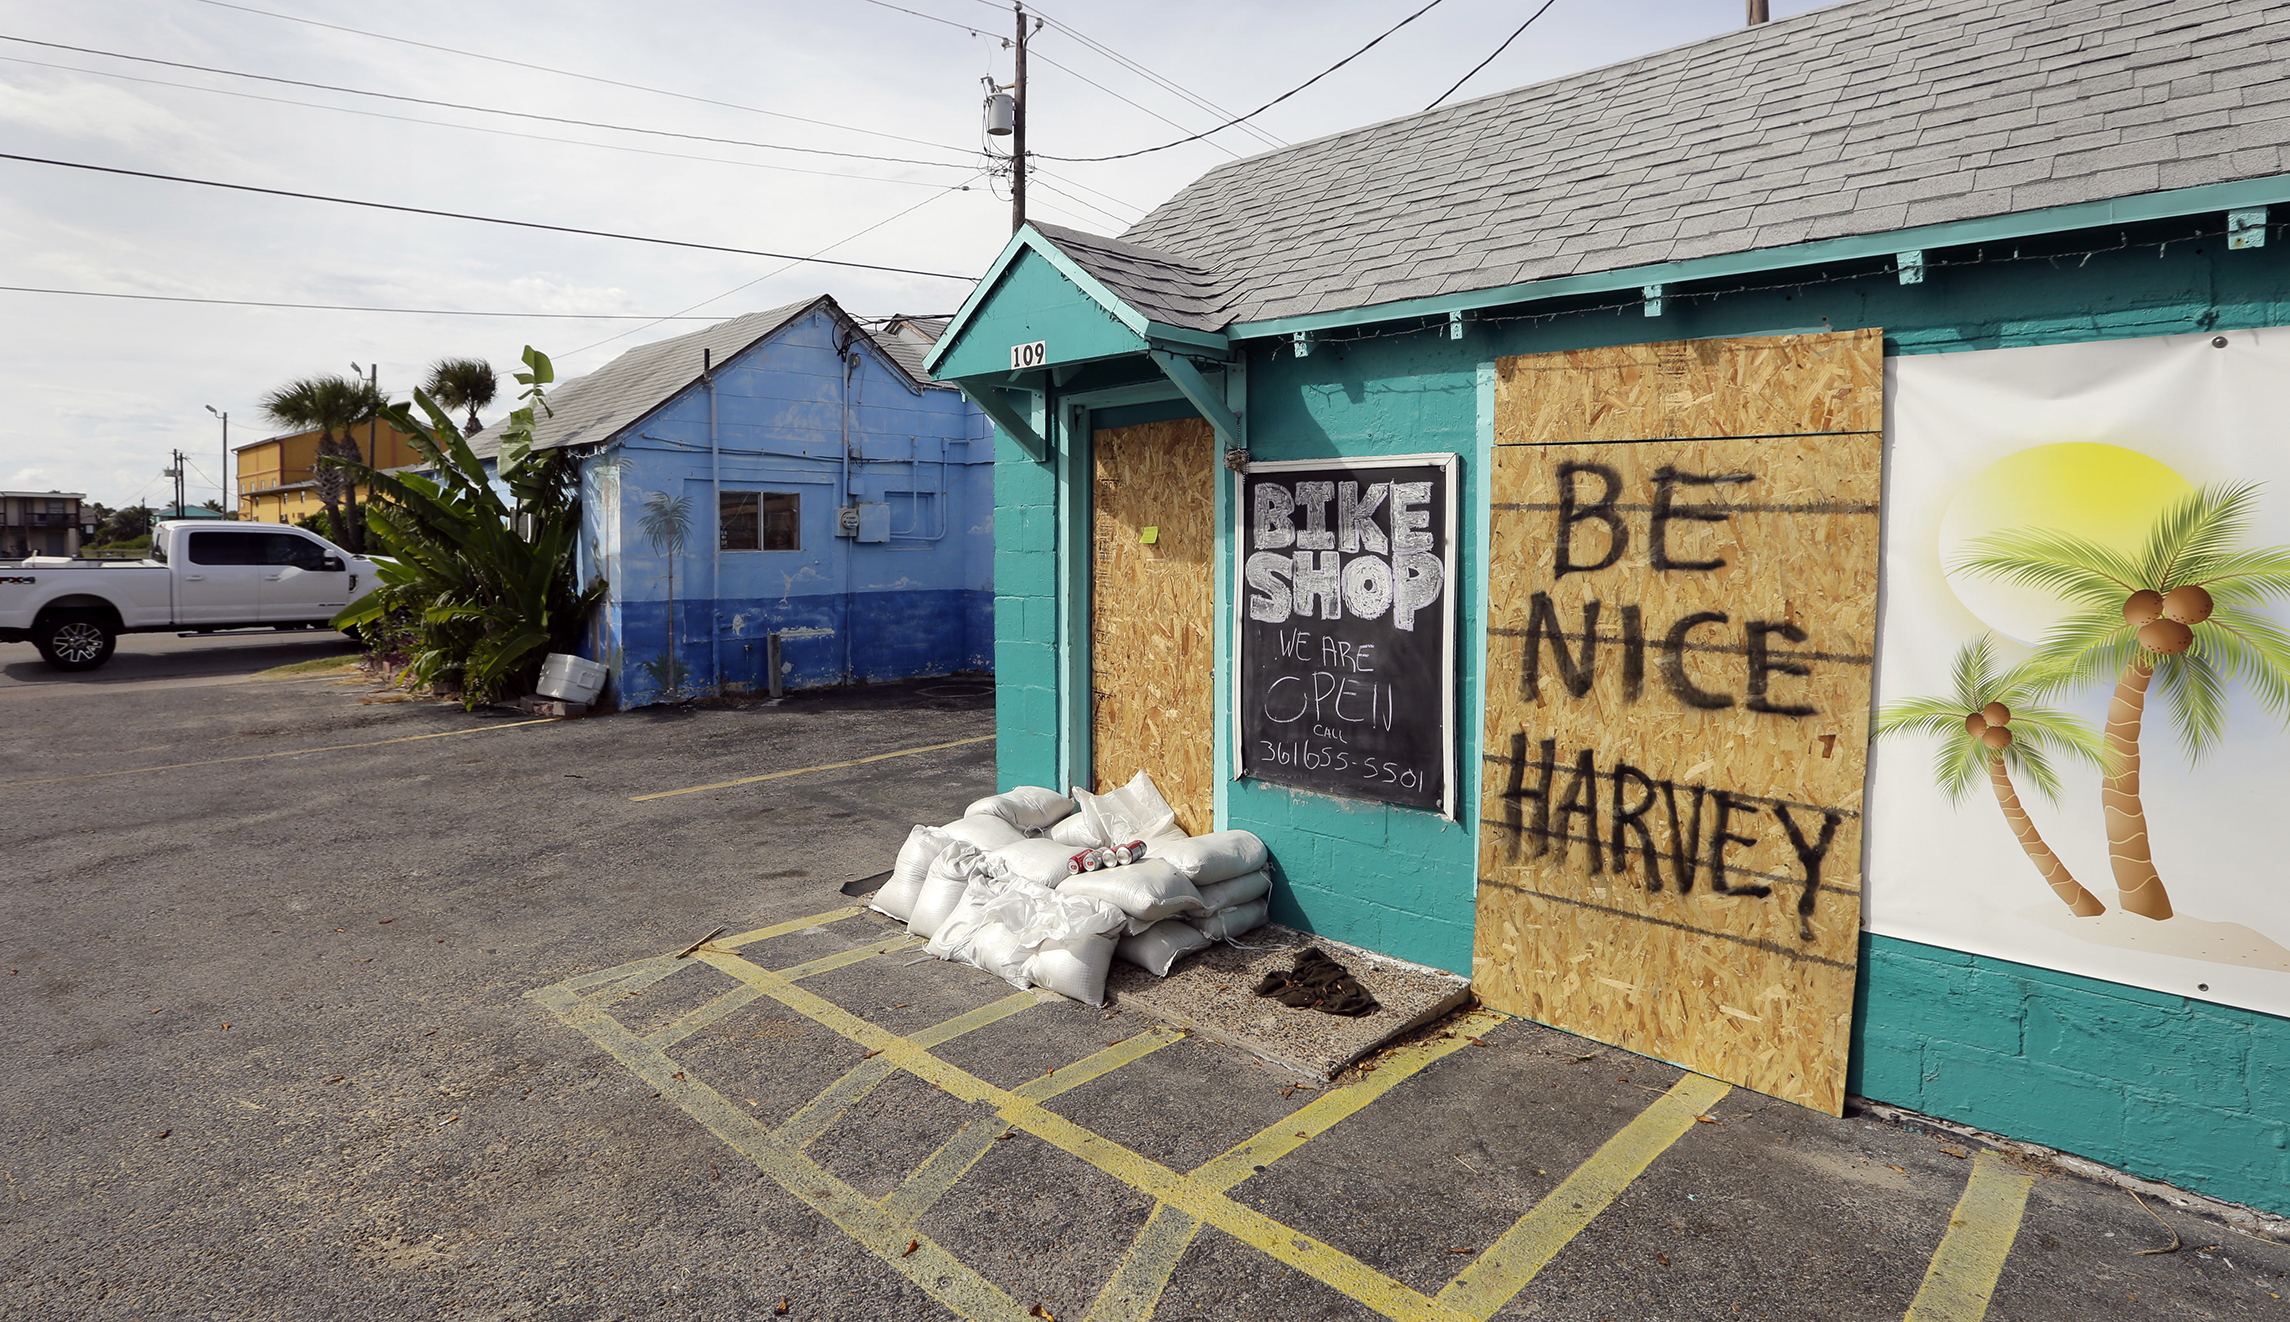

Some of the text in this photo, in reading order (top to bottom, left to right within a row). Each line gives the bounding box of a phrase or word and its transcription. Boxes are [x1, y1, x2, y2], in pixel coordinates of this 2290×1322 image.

[1013, 343, 1044, 367] 109
[1254, 479, 1434, 555] BIKE
[1555, 461, 1755, 580] BE
[1245, 550, 1445, 632] SHOP
[1279, 627, 1375, 673] WE ARE
[1519, 591, 1820, 716] NICE
[1264, 670, 1393, 732] OPEN
[1313, 723, 1348, 744] CALL
[1500, 732, 1842, 942] HARVEY
